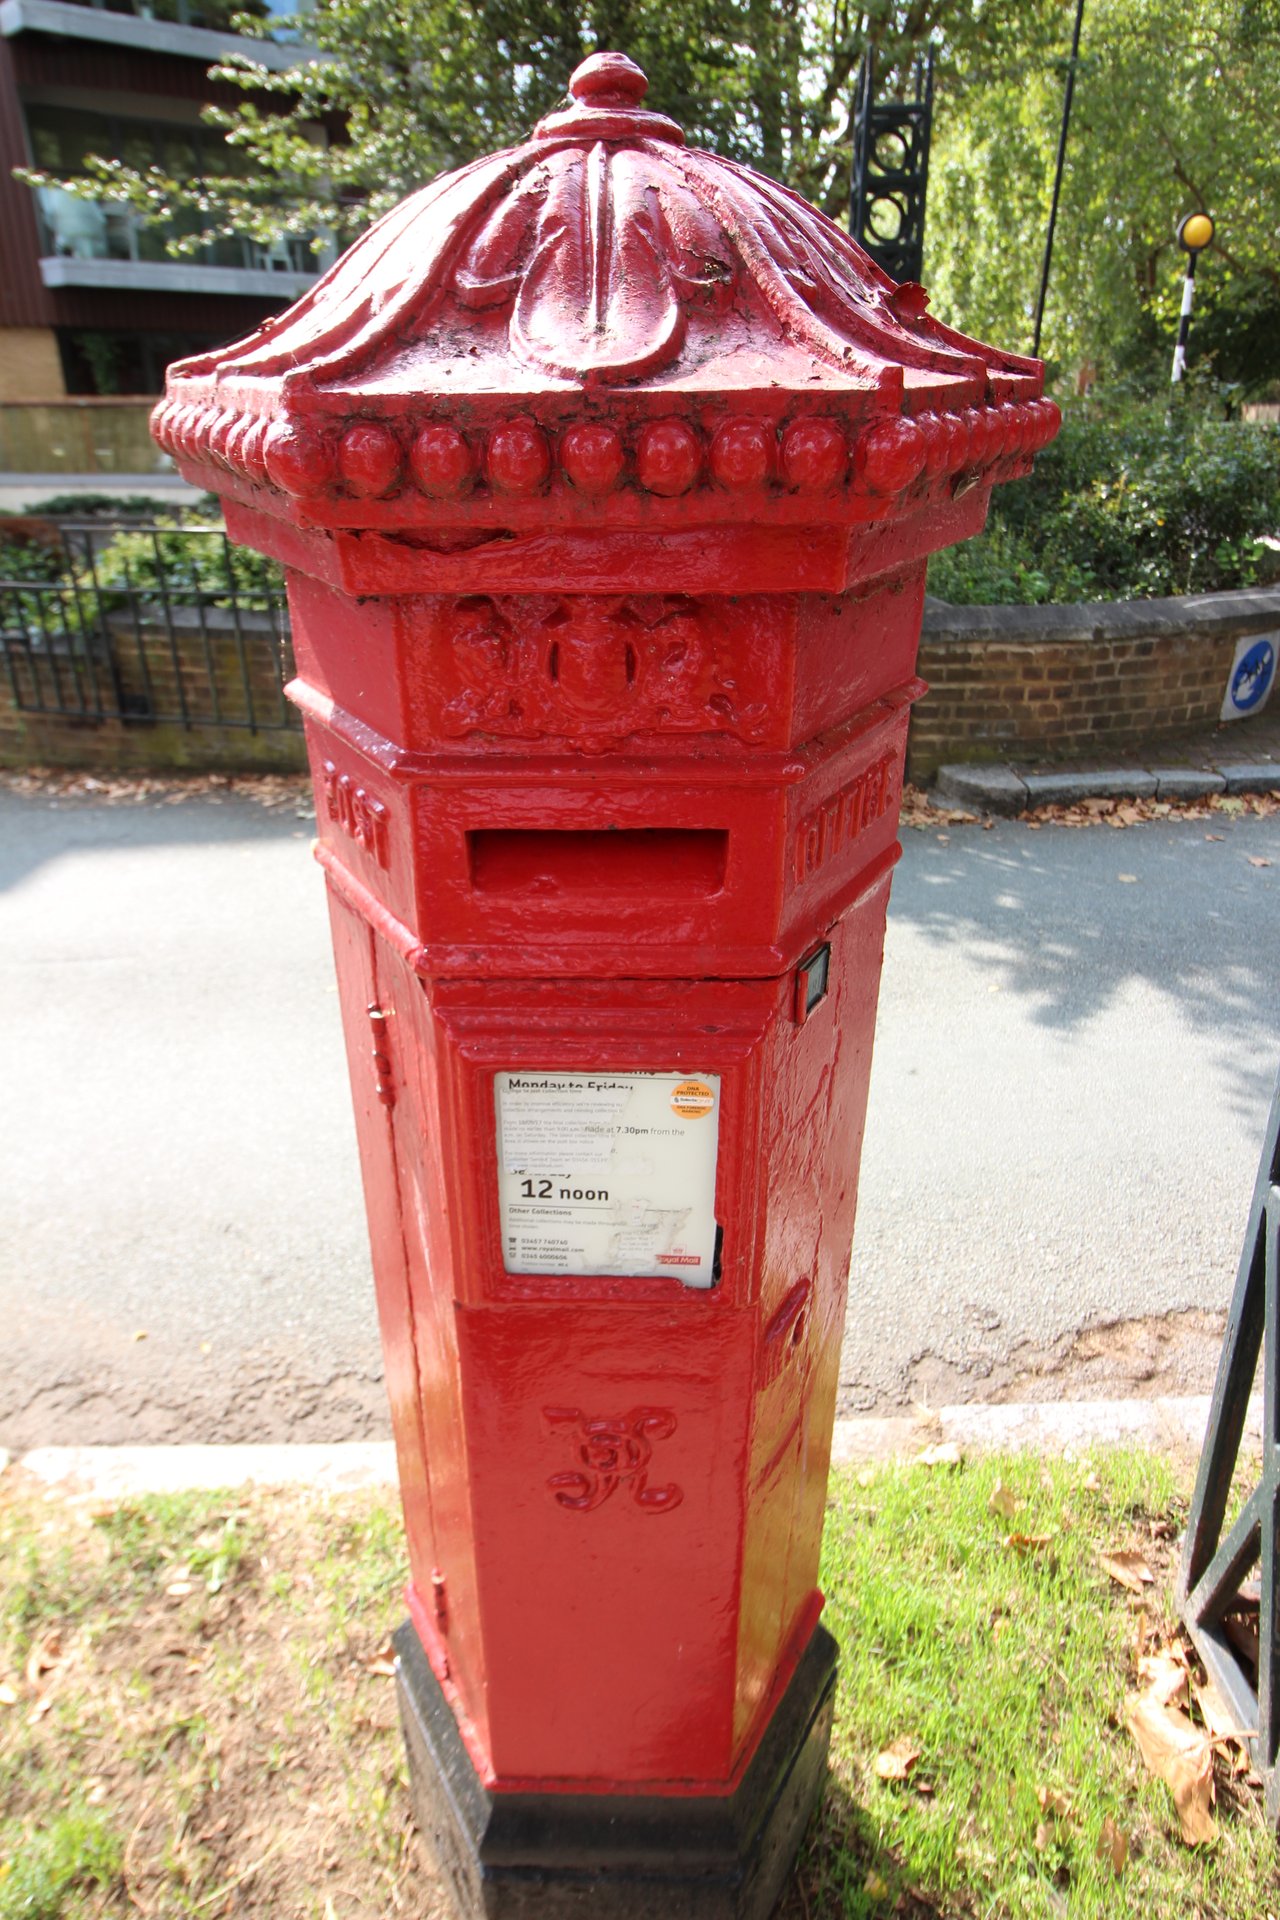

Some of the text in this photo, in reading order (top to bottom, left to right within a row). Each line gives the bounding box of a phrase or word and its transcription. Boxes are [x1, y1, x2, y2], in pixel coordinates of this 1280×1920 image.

[616, 1126, 648, 1135] 7.30pm
[520, 1179, 609, 1201] 12 noon
